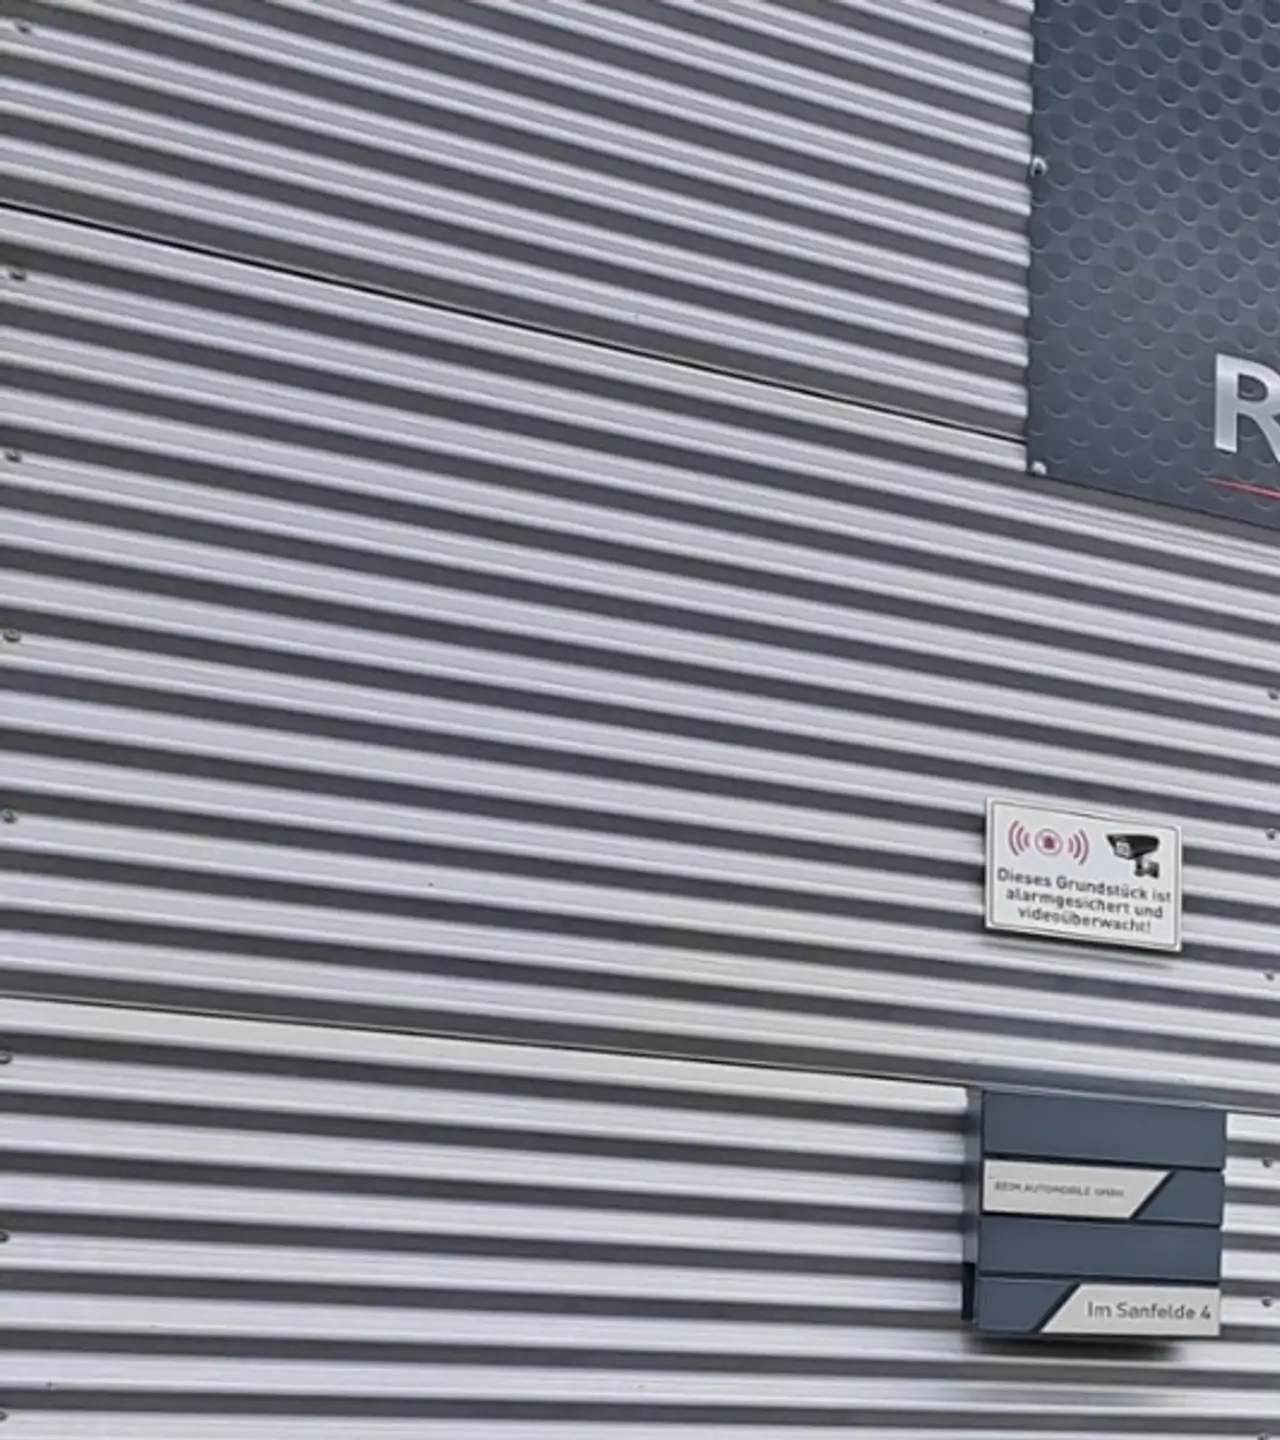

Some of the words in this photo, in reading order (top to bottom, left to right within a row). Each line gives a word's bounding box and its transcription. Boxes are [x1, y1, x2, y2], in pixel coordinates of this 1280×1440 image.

[997, 867, 1051, 888] Dieses
[1056, 876, 1147, 901] Grundstück
[1152, 888, 1172, 903] ist
[1006, 888, 1131, 917] alarmgesichert
[1134, 904, 1164, 919] und
[1018, 906, 1152, 934] videoüberwacht!
[1087, 1301, 1112, 1318] Im
[1116, 1301, 1196, 1320] Sanfelde
[1199, 1305, 1212, 1320] 4
